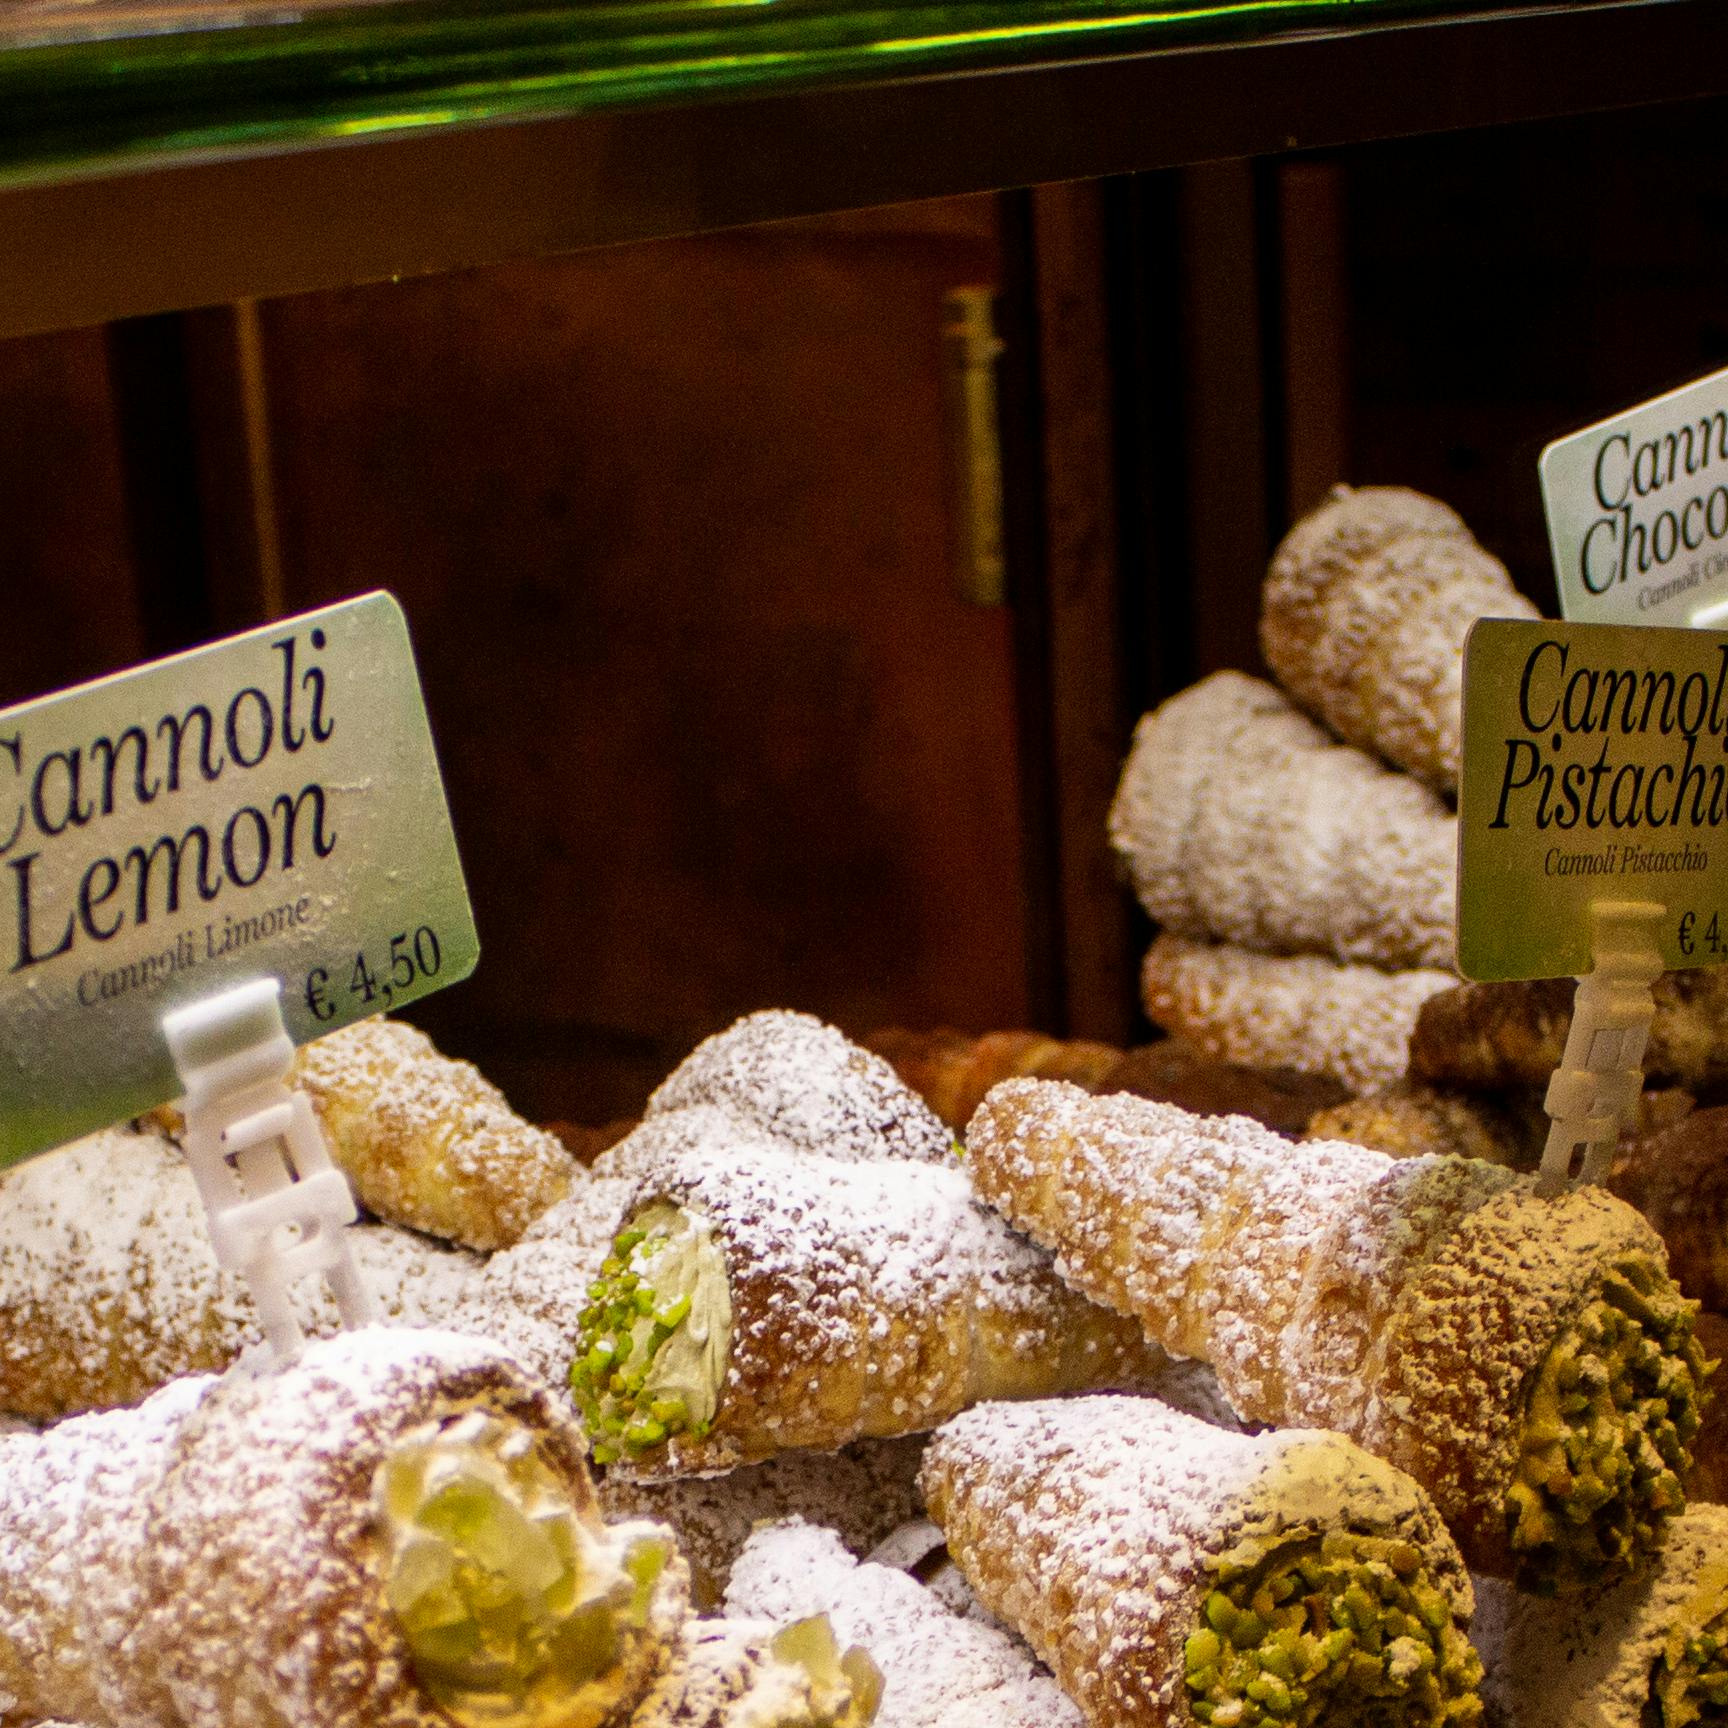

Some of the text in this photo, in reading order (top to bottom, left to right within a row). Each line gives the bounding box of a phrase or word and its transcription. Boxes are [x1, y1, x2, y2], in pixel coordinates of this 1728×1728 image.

[8, 782, 336, 975] Lemon
[1544, 843, 1709, 877] Cannoli Pistacchio
[78, 897, 311, 1007] Cannoli Limone
[304, 925, 441, 1021] € 4,50
[1679, 911, 1696, 955] €
